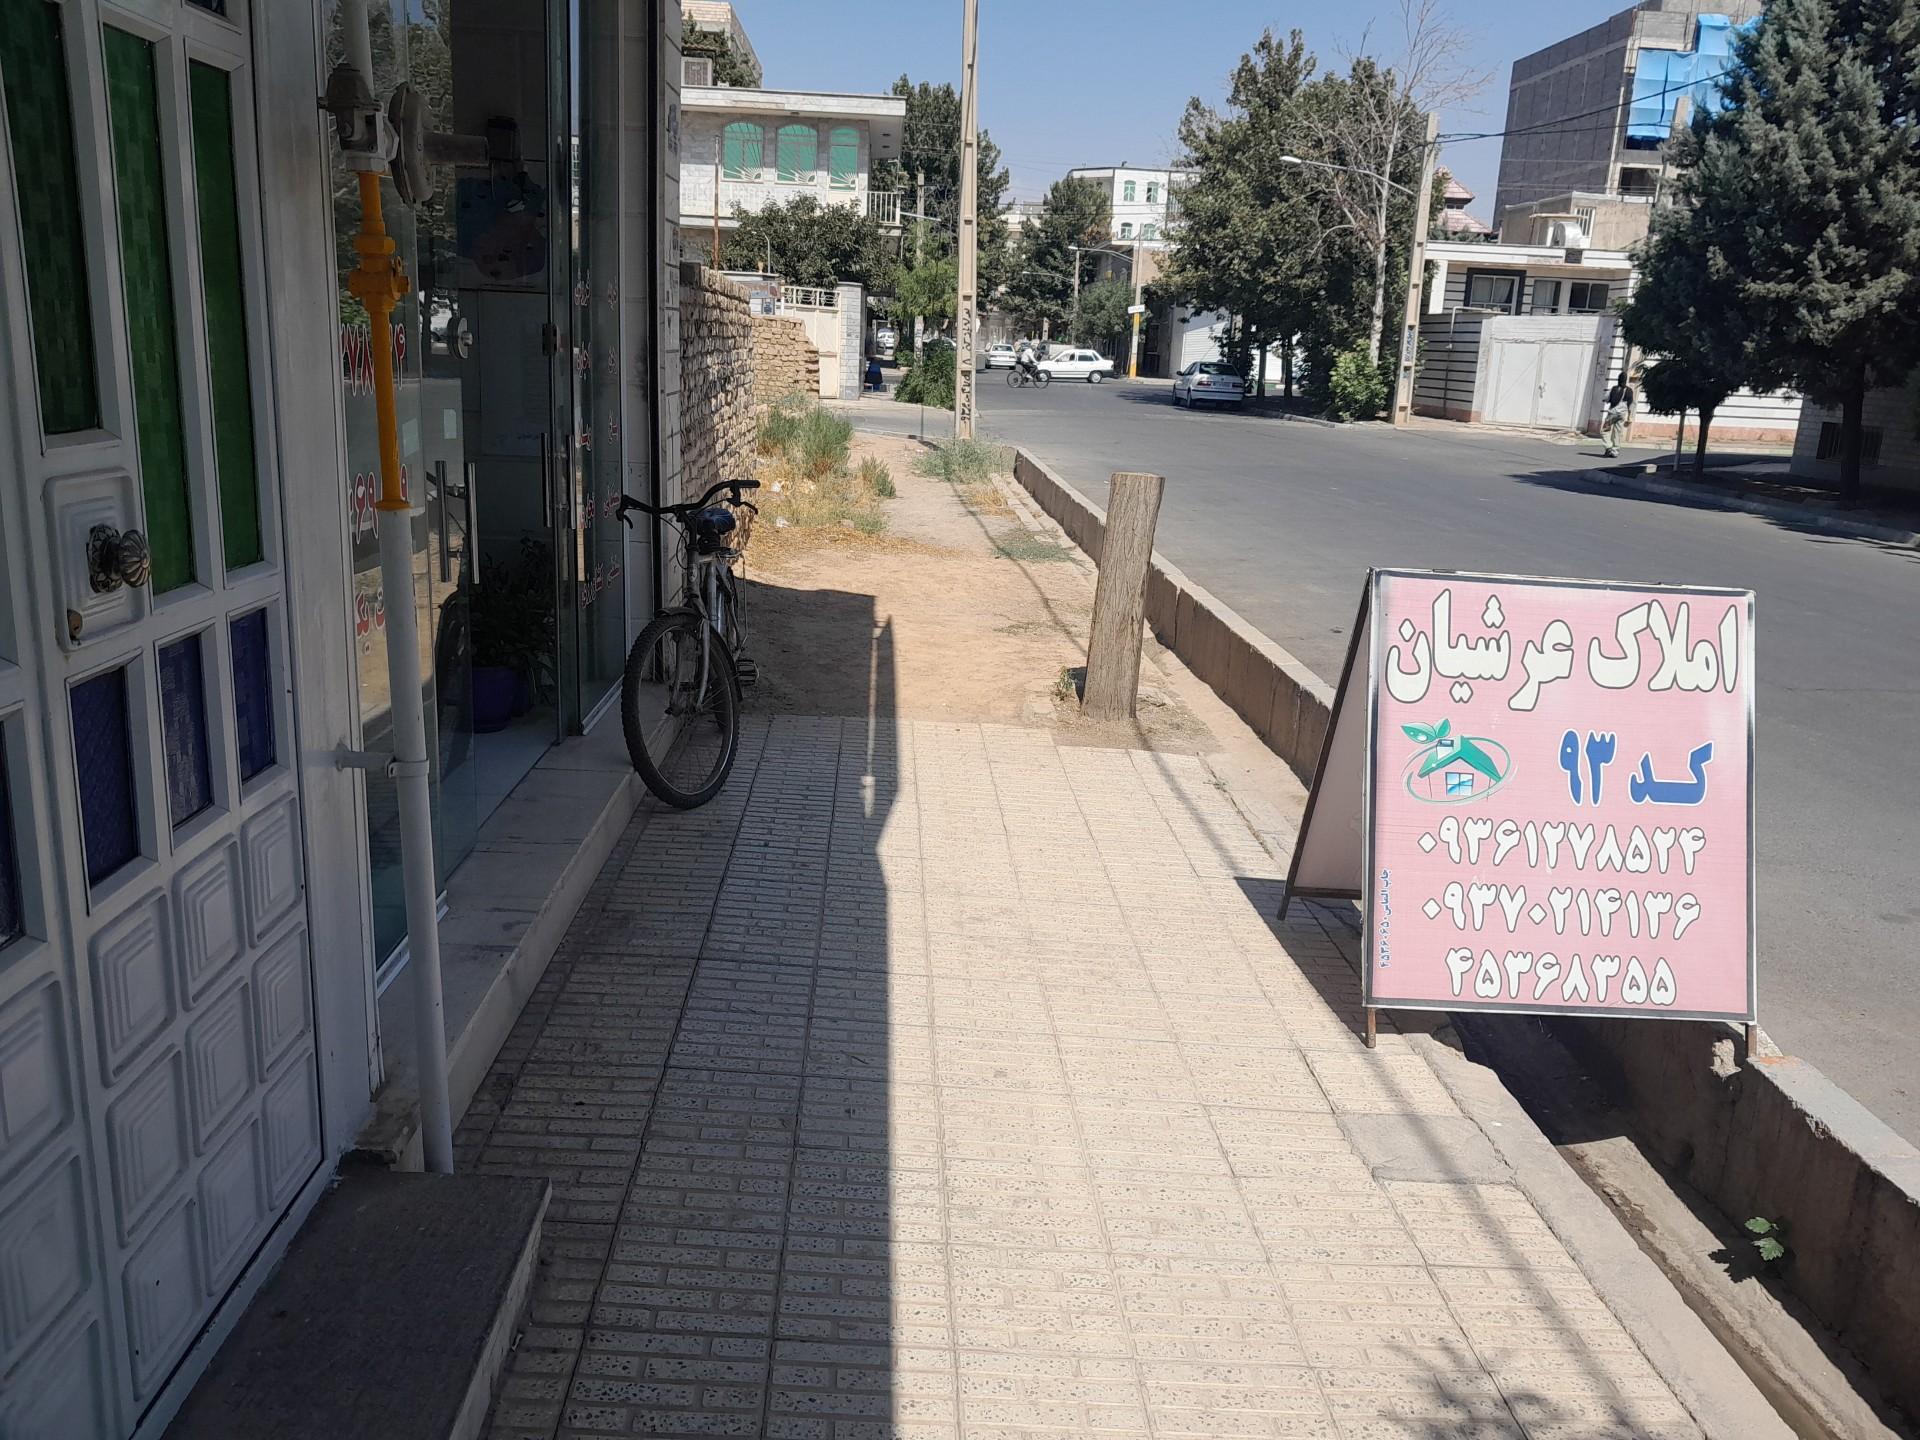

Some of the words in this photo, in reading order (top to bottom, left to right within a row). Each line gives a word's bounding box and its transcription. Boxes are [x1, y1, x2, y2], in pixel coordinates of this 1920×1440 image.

[1386, 588, 1574, 711] عرشیان
[1588, 599, 1739, 693] املاک
[1558, 728, 1617, 807] ۹۳
[1628, 740, 1713, 806] کد
[1417, 815, 1706, 875] ۰۹۳۶۱۲۷۸۵۲۴
[1422, 881, 1701, 940] ۰۹۳۷۰۲۱۴۱۳۶
[1445, 947, 1677, 1006] ۴۵۳۶۸۳۵۵
